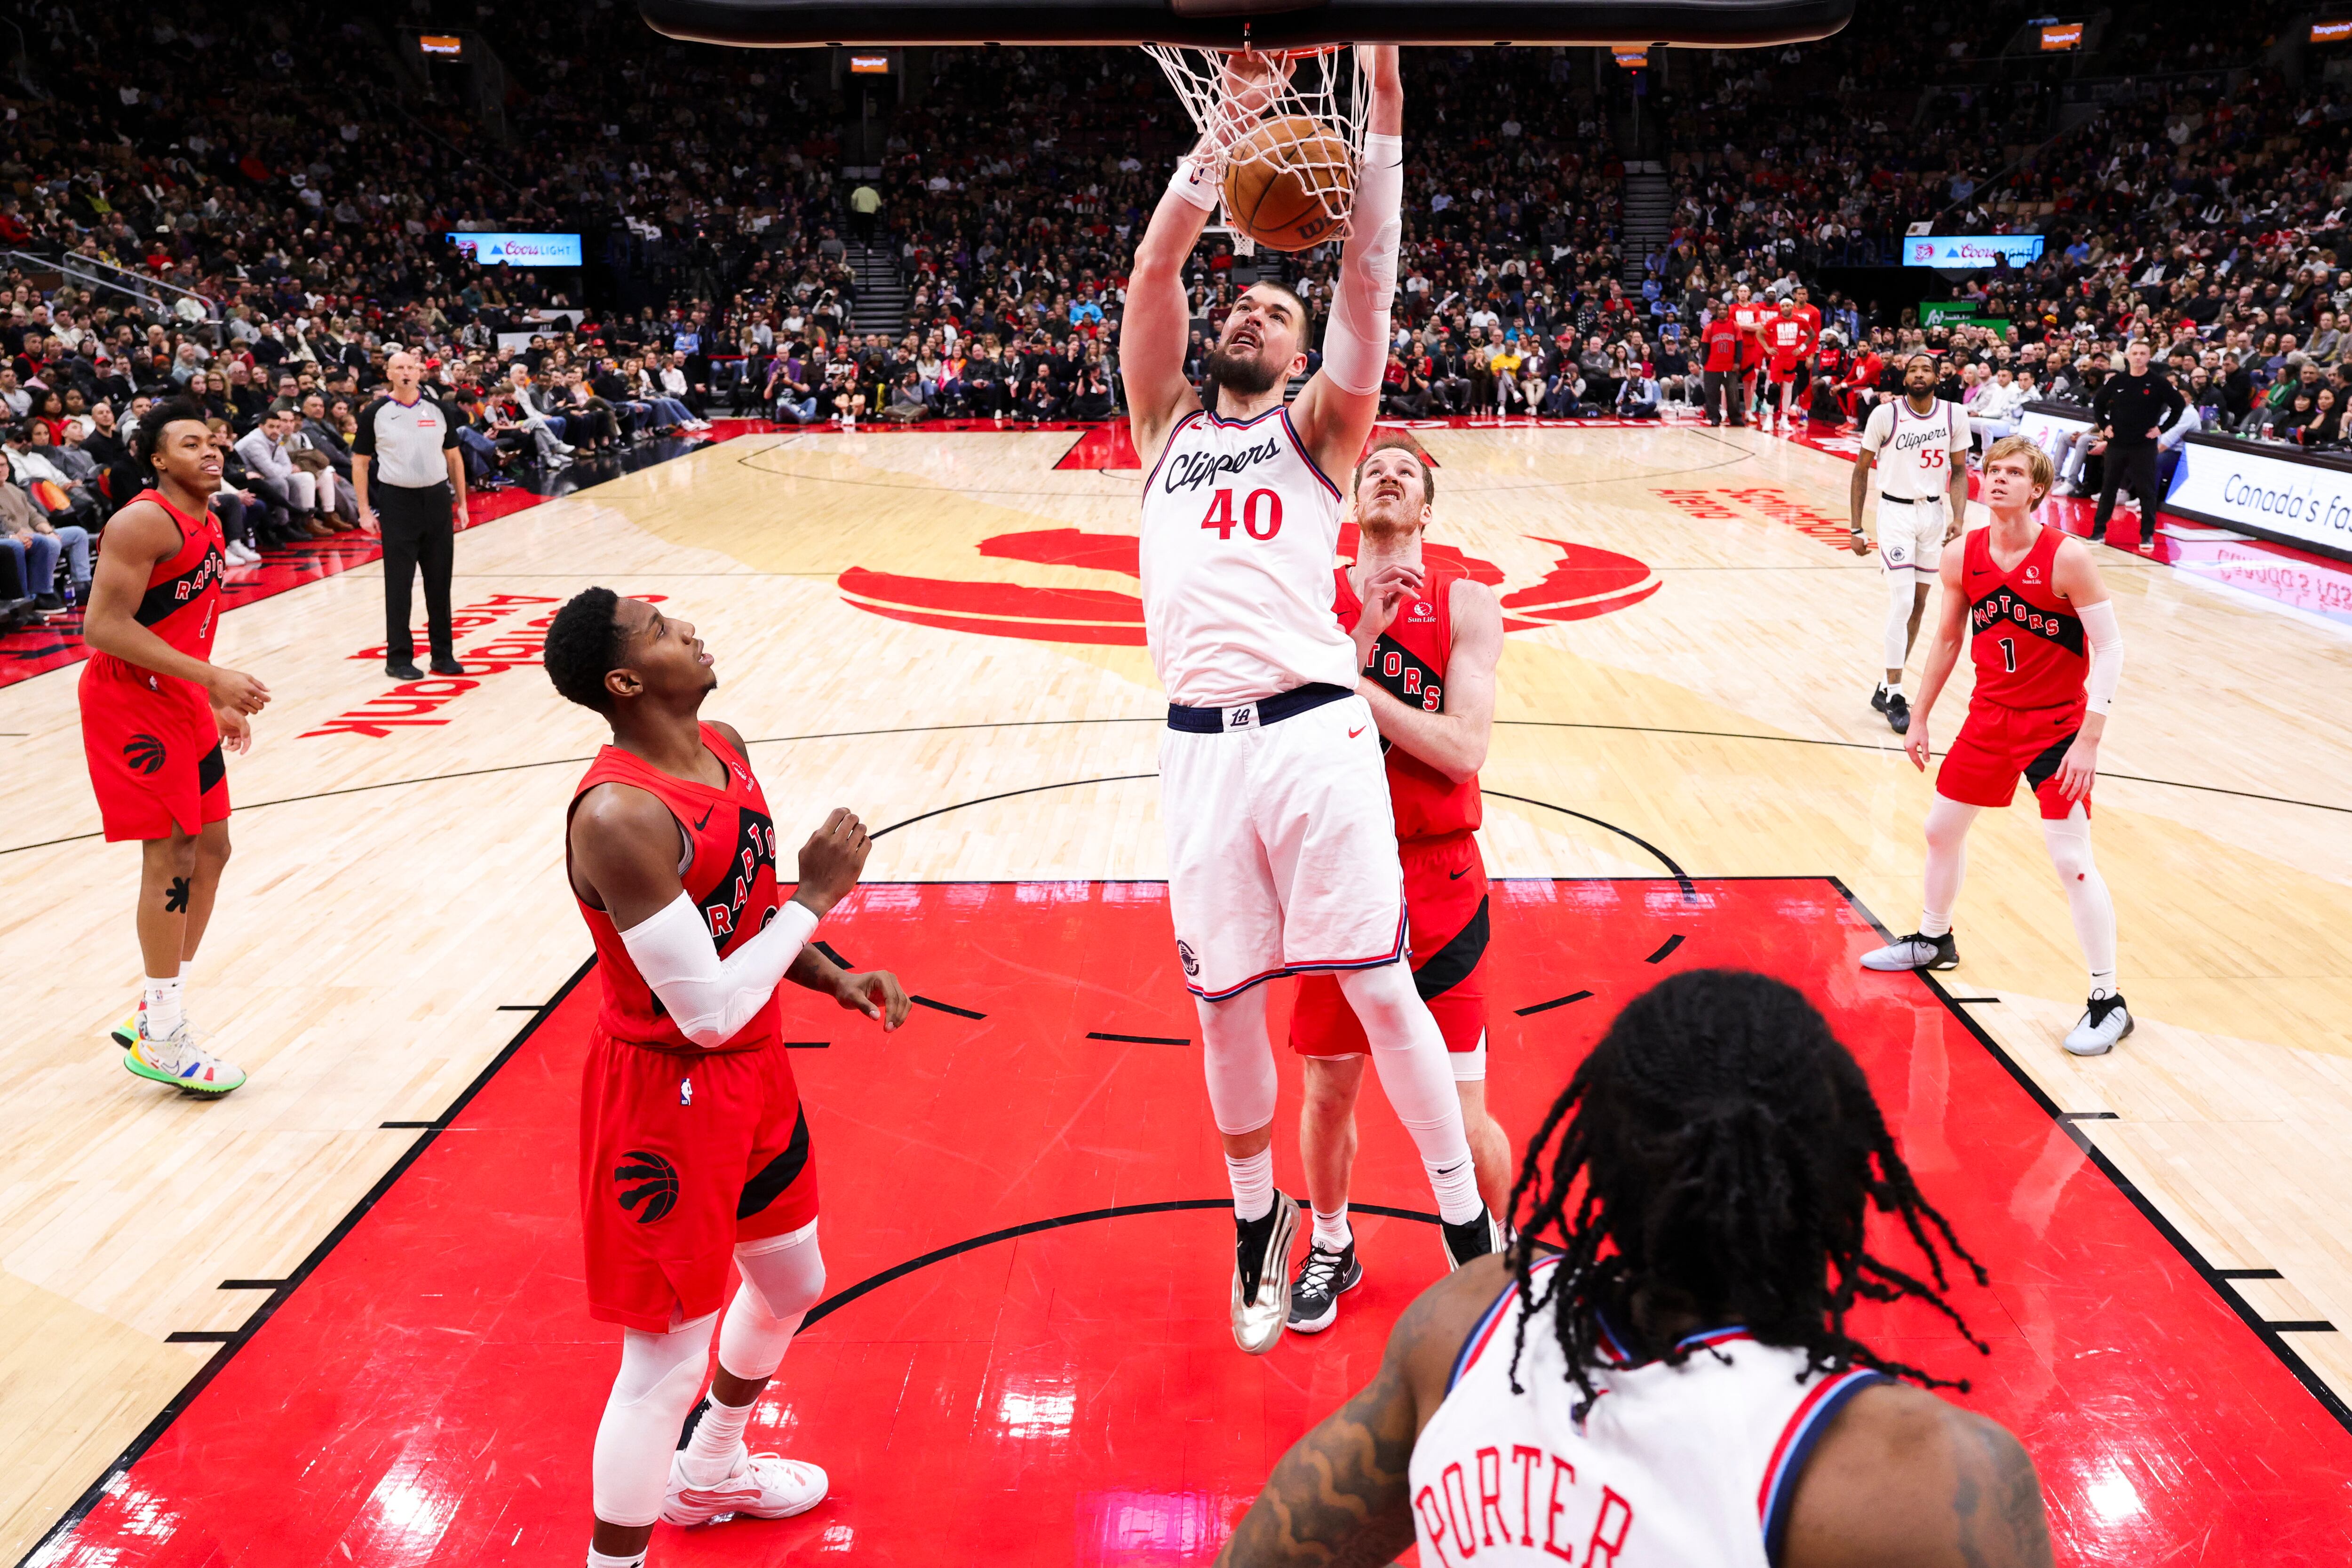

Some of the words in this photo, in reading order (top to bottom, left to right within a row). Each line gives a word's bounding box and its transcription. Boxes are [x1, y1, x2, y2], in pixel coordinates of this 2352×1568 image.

[505, 240, 539, 255] Coors
[540, 246, 571, 255] LIGHT
[1961, 243, 1995, 258] Coors
[1896, 427, 1947, 450] Clippers
[1920, 449, 1944, 468] 55
[1166, 437, 1281, 494] Clippers
[1201, 488, 1283, 541] 40
[2225, 474, 2320, 522] Canada's
[175, 552, 224, 600] RAPTO
[1974, 595, 2059, 636] RAPTORS
[1997, 637, 2017, 673] 1
[1366, 643, 1441, 712] TORS
[1230, 708, 1250, 727] LA
[706, 822, 776, 938] RAPTO
[1415, 1444, 1633, 1568] PORTER
